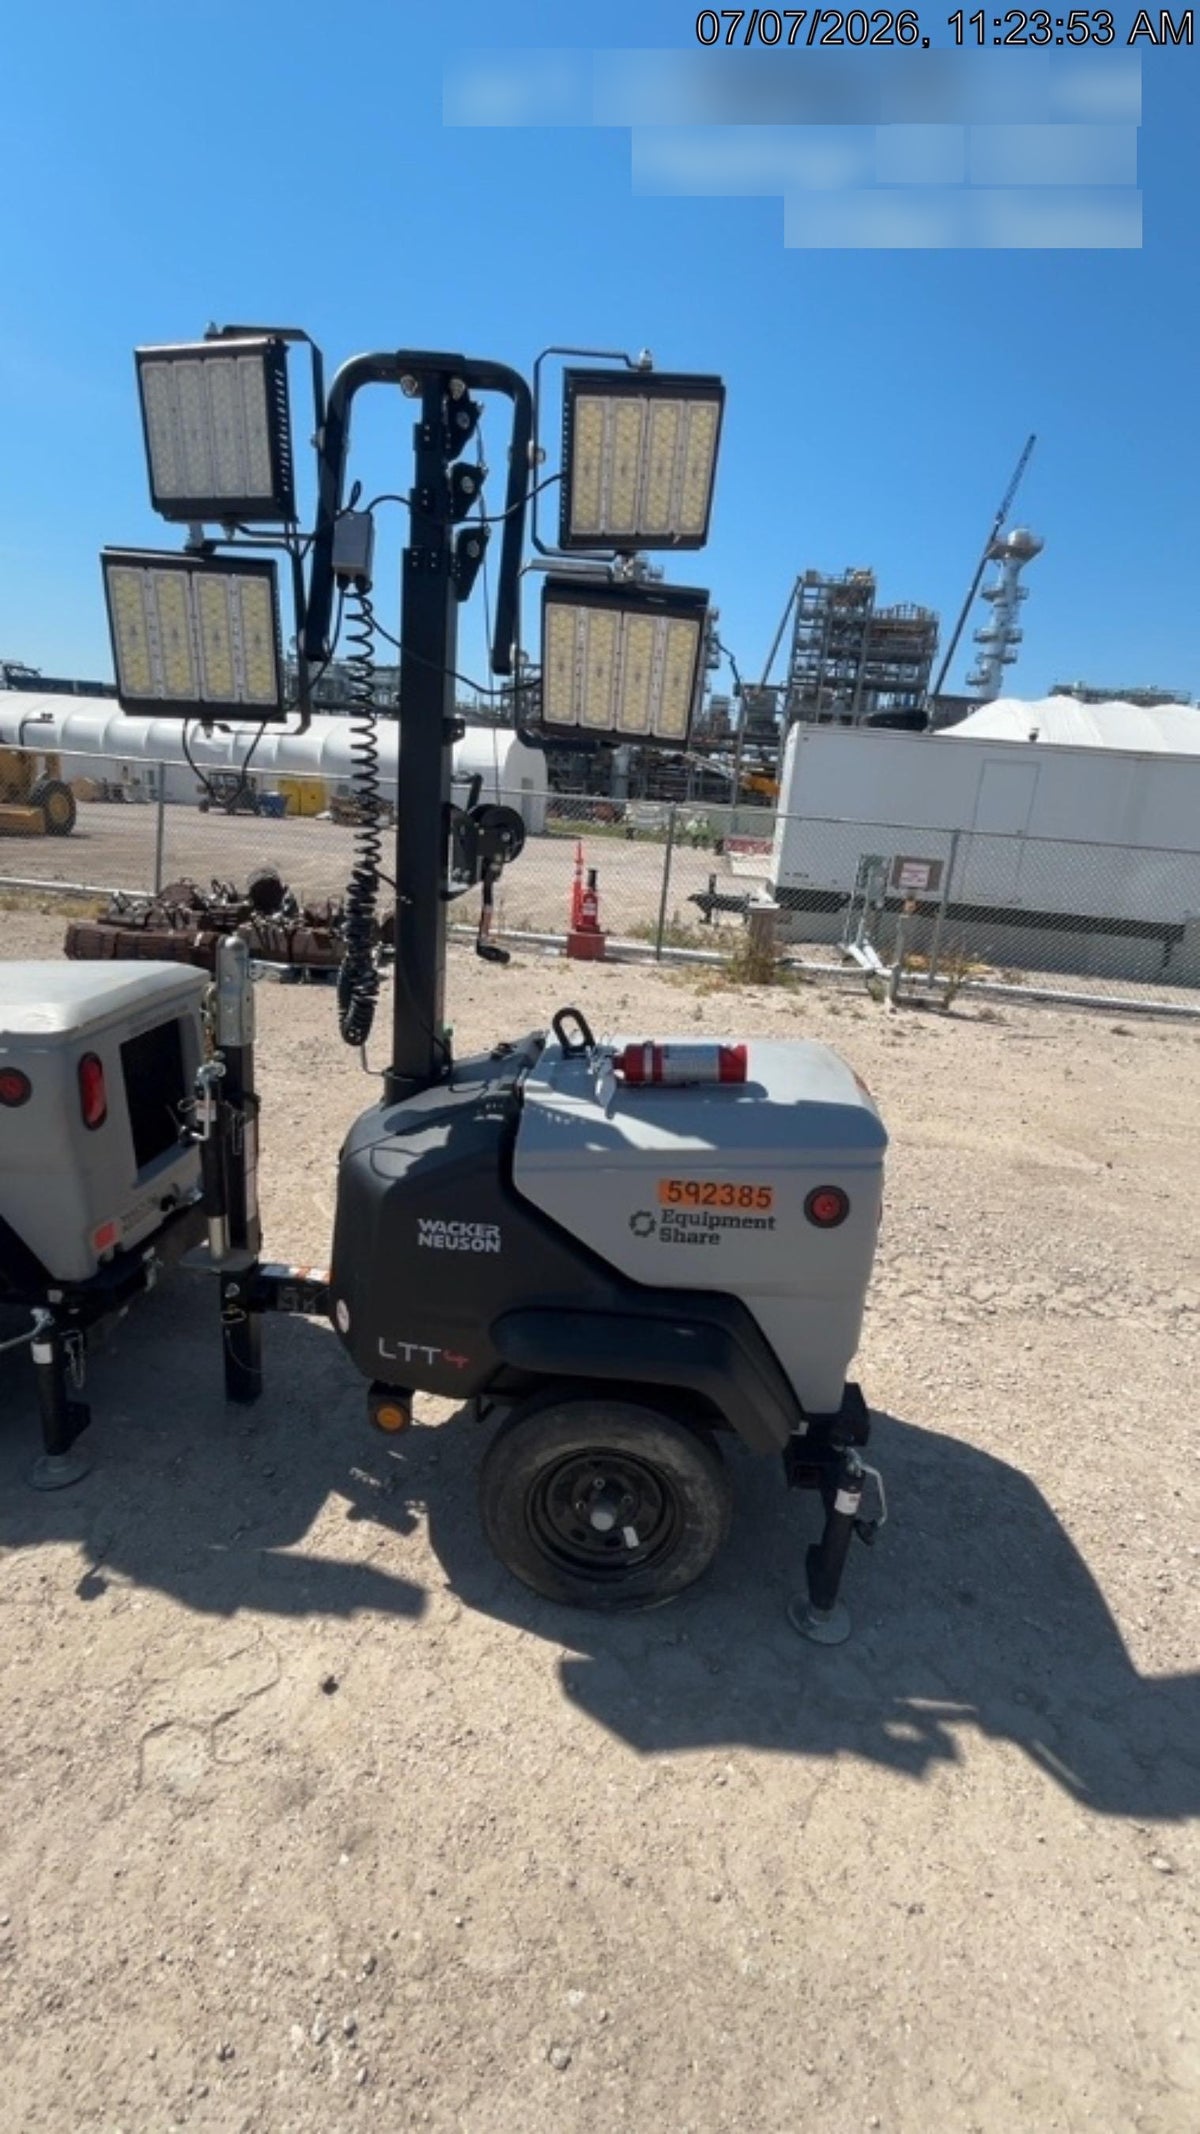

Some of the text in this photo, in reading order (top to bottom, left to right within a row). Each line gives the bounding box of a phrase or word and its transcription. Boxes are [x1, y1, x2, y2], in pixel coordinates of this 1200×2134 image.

[667, 1180, 773, 1208] 592385
[418, 1218, 501, 1239] WACKER
[661, 1208, 776, 1231] Equipment
[418, 1232, 501, 1253] NEUSON
[659, 1227, 721, 1245] Share
